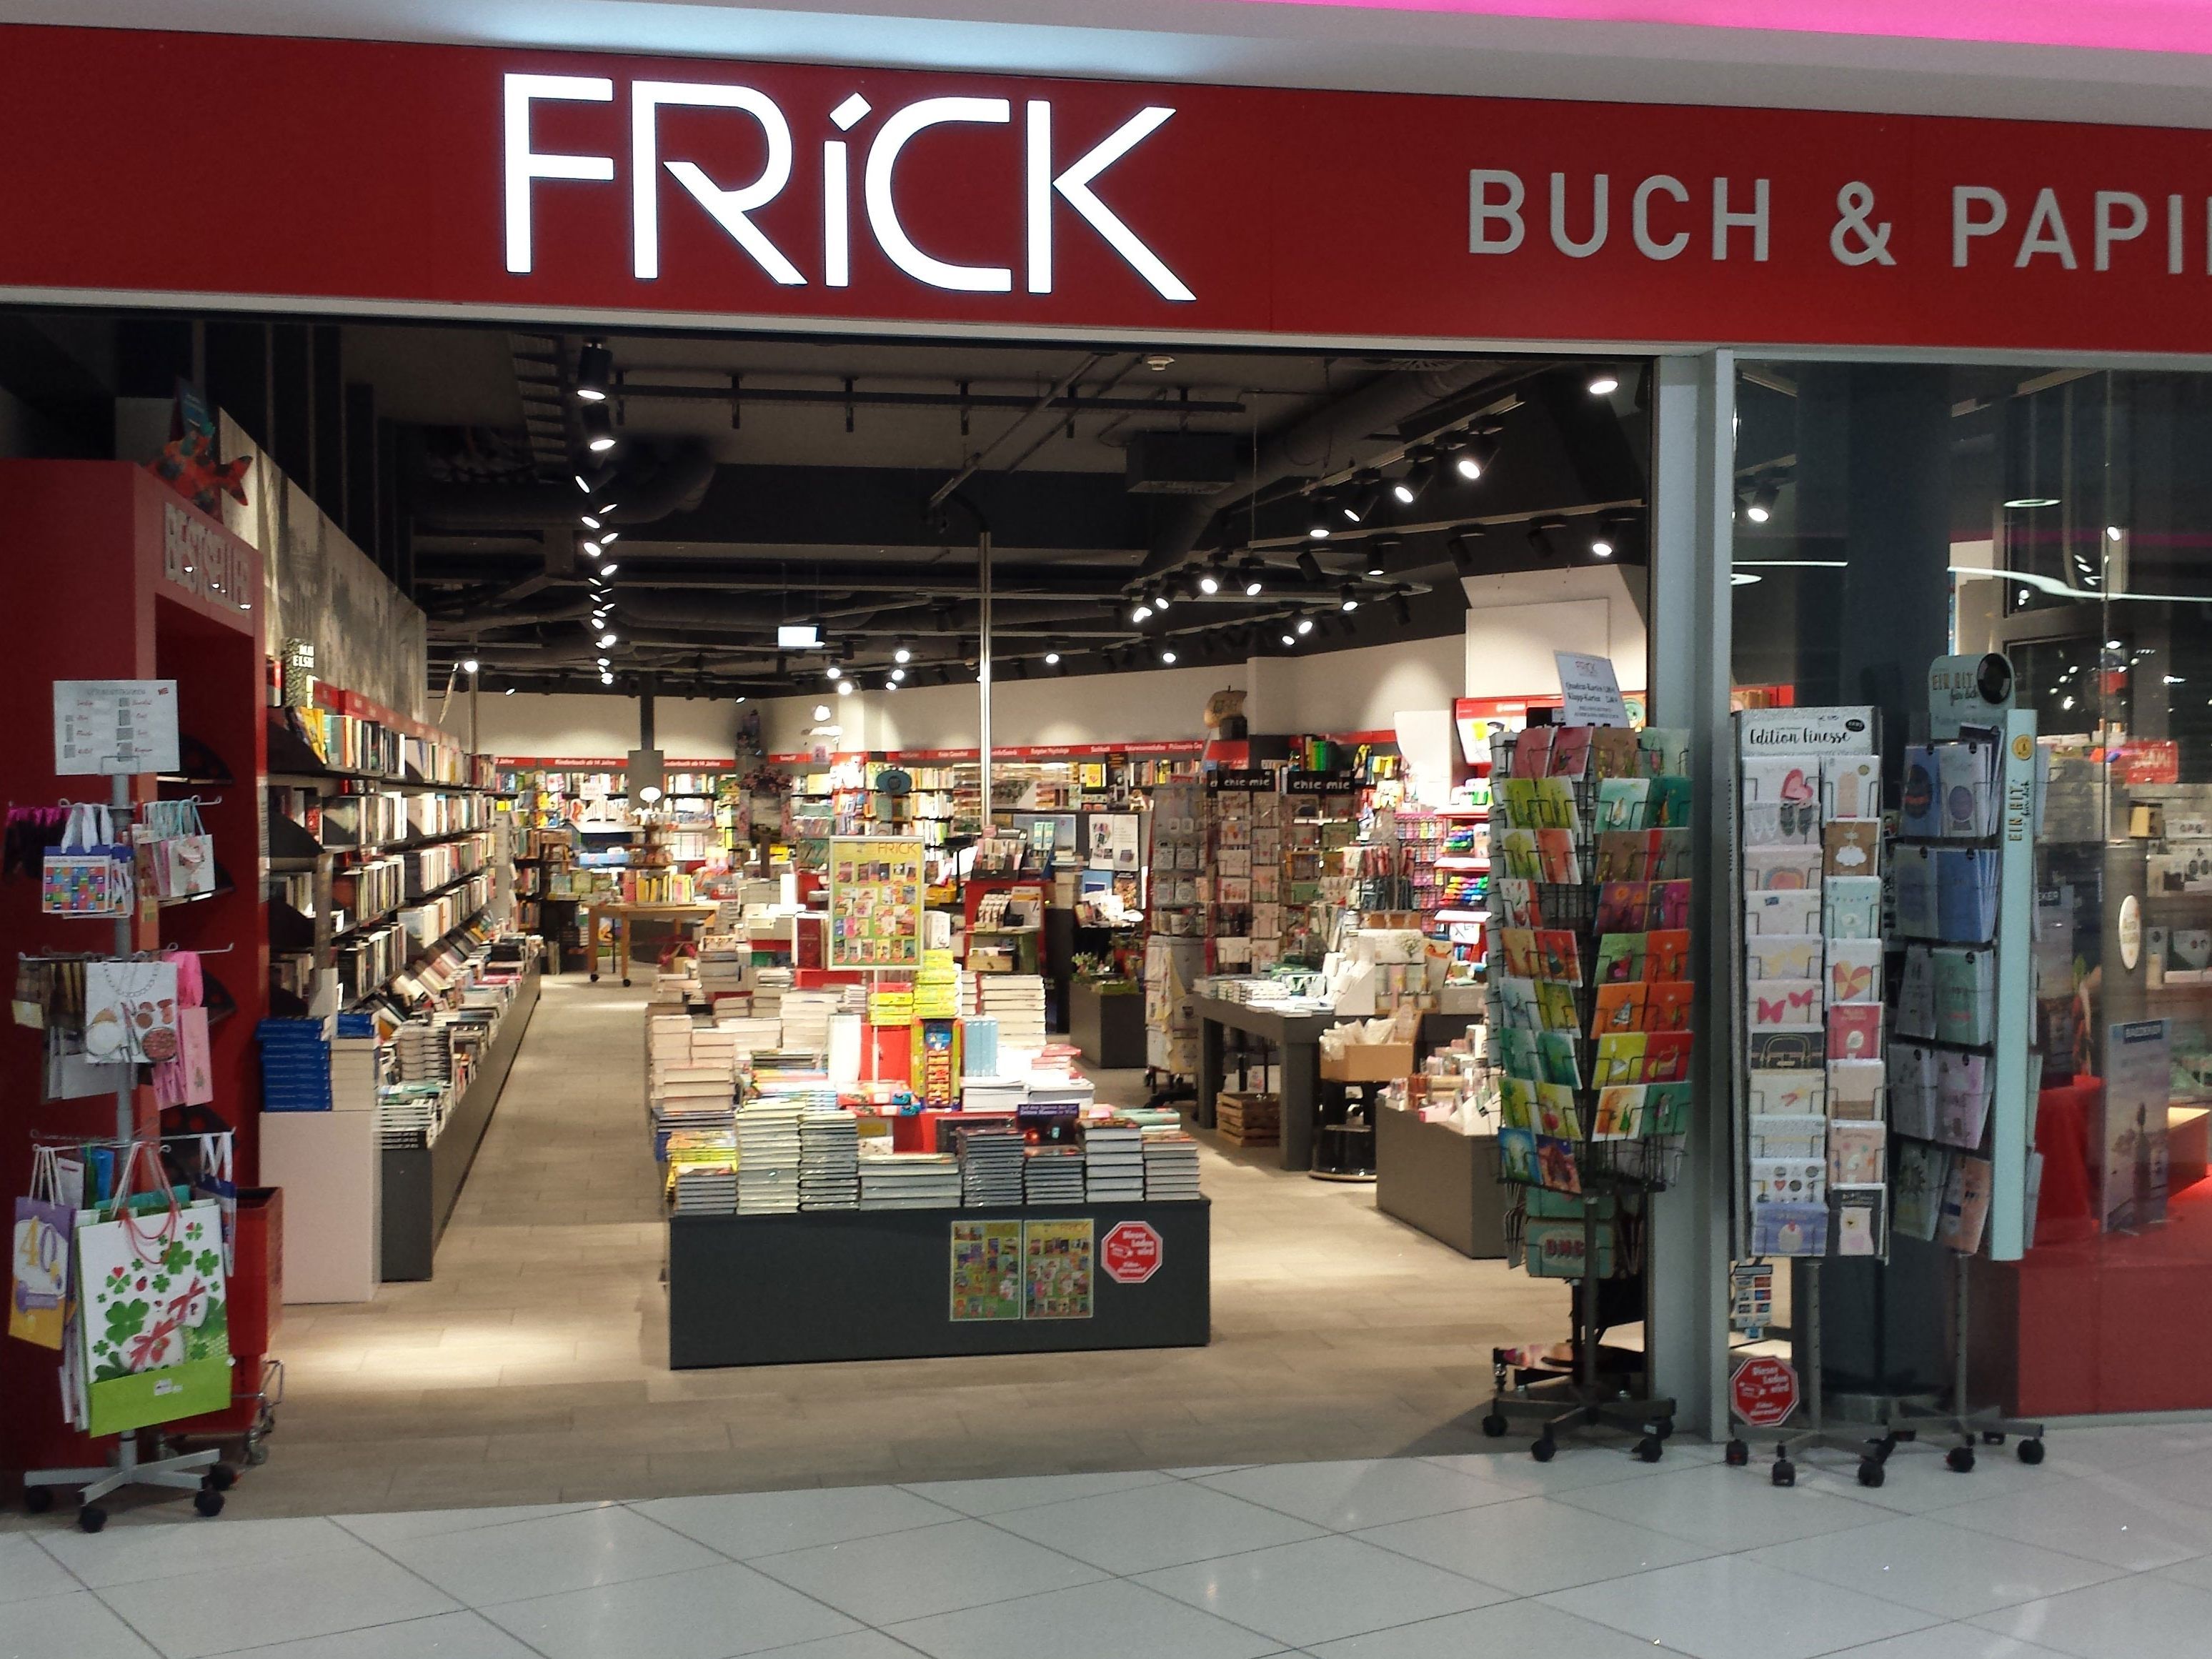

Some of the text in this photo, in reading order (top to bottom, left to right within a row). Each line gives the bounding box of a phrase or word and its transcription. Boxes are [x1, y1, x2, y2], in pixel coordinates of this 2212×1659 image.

[1470, 169, 2212, 275] BUCH & PAPI
[1750, 728, 1800, 745] Edition
[1293, 780, 1350, 790] chic mic
[877, 842, 918, 855] FRICK
[20, 1215, 57, 1272] 40
